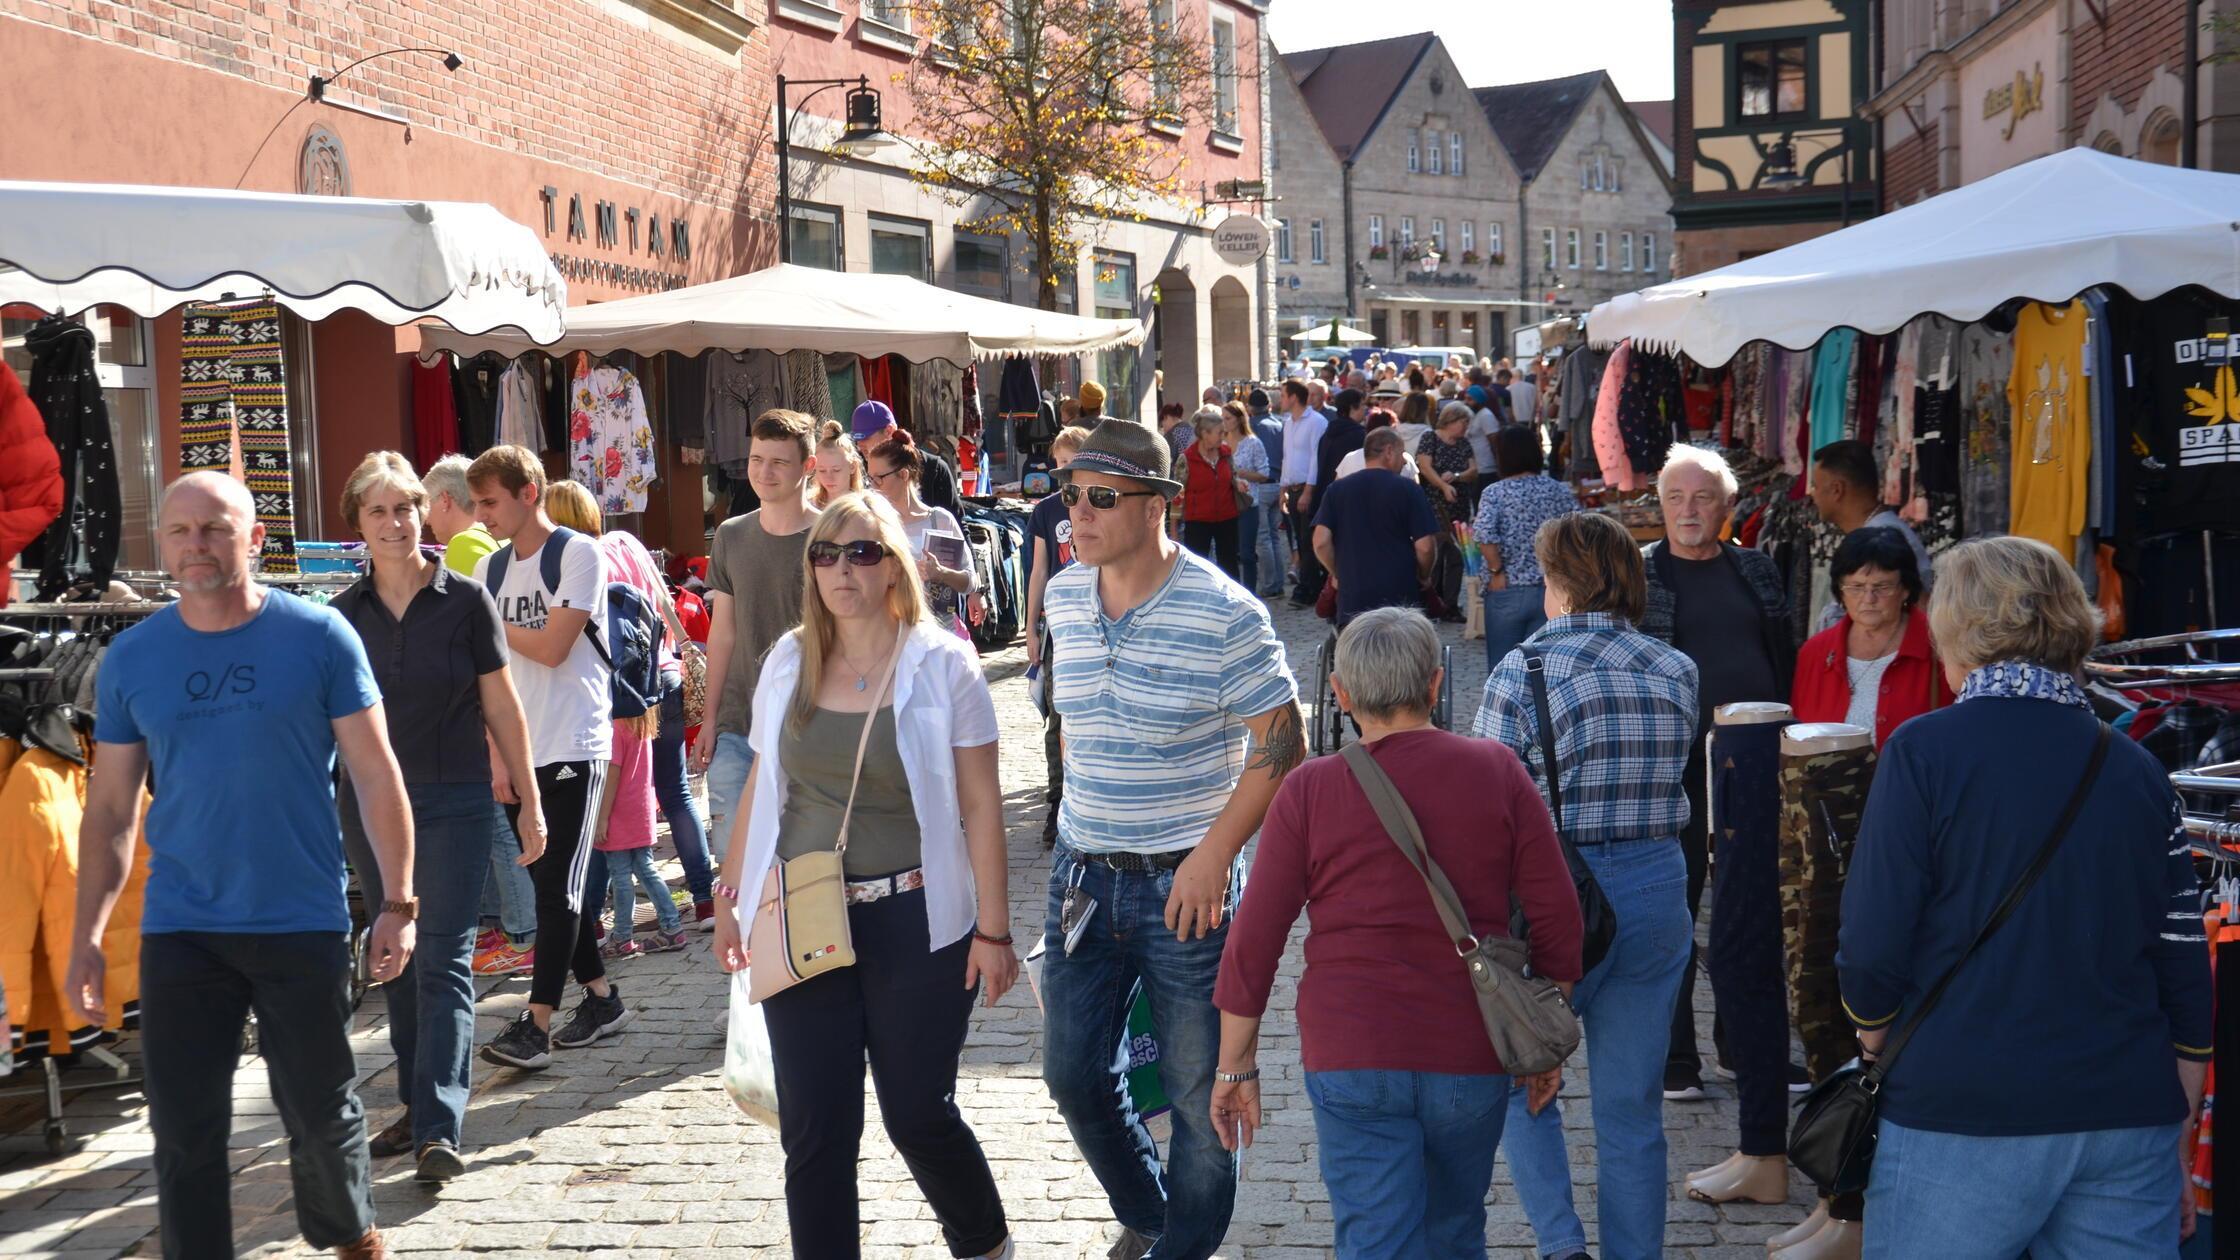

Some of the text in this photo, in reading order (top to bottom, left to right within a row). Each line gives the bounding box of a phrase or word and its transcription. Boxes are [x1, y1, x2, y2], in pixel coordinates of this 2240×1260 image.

[541, 184, 690, 261] TAMTAM
[1218, 231, 1260, 242] LÖWEN-
[1218, 242, 1259, 252] KELLER
[2186, 428, 2240, 446] SPA
[184, 662, 256, 702] Q/S
